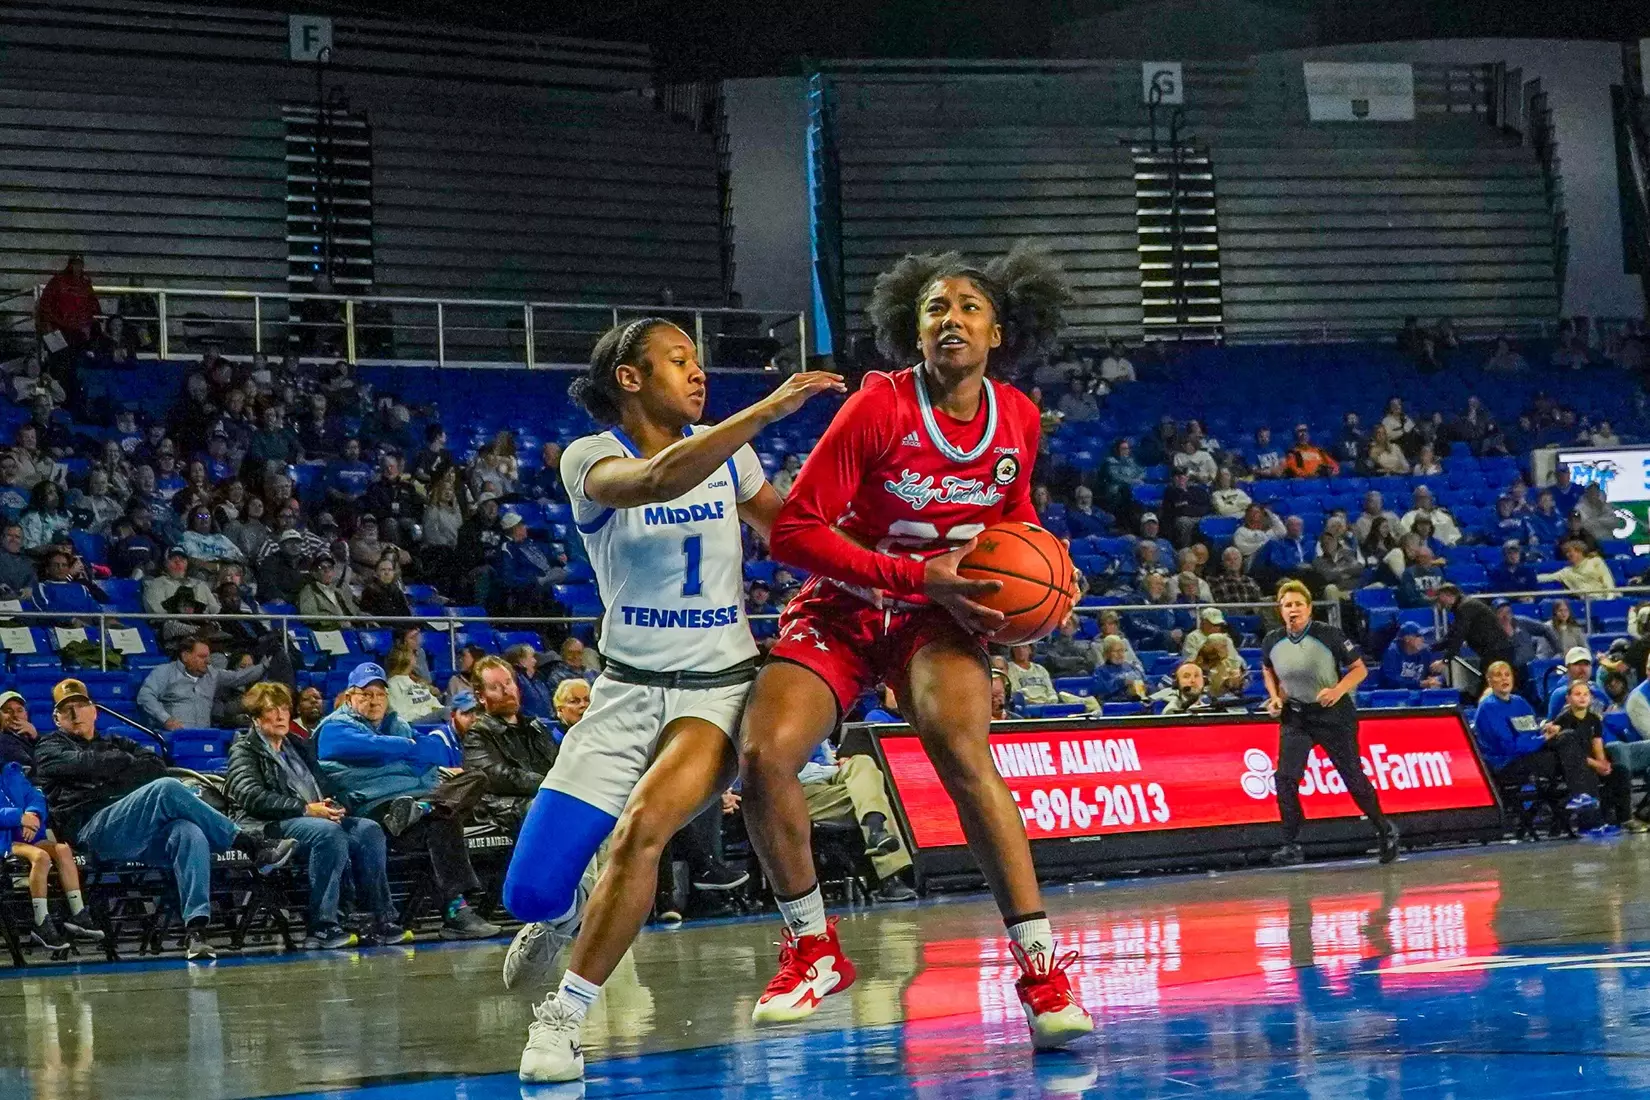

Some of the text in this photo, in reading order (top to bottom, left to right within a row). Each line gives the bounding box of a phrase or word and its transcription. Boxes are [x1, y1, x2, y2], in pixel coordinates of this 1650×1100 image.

[303, 25, 319, 51] F
[1152, 70, 1175, 95] G
[707, 480, 729, 489] C-USA
[884, 469, 936, 510] Lady
[644, 501, 724, 526] MIDDLE
[681, 533, 703, 598] 1
[989, 738, 1142, 777] NNIE ALMON
